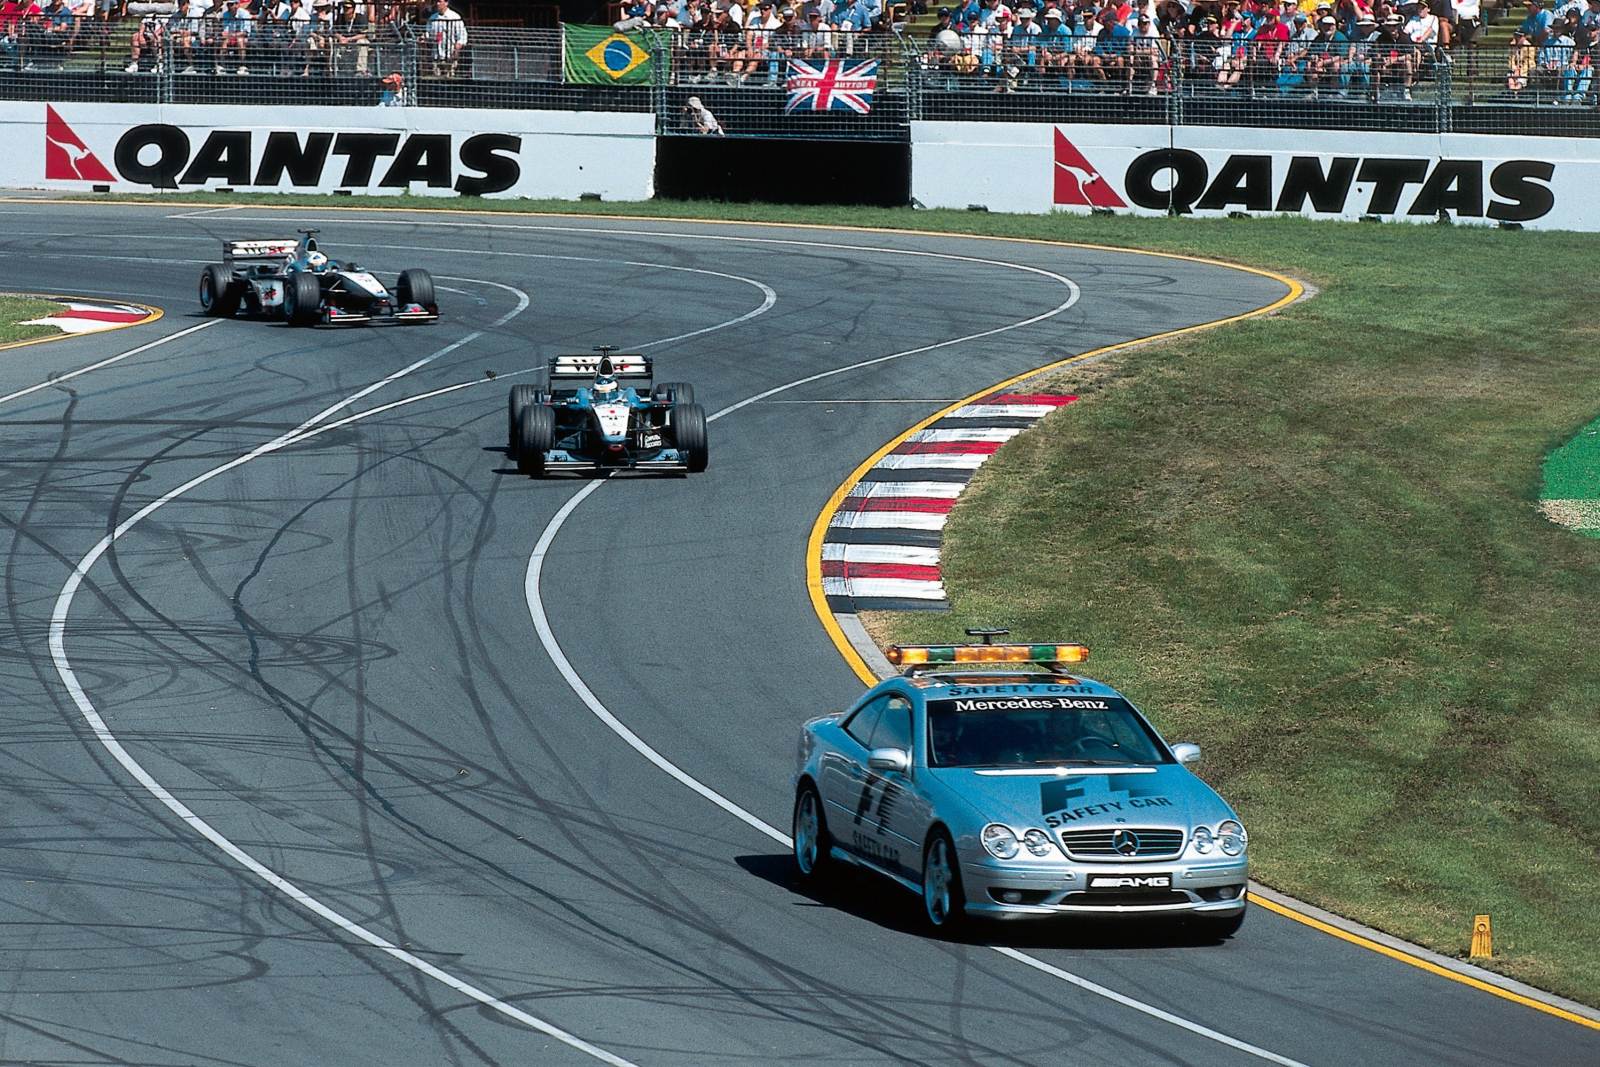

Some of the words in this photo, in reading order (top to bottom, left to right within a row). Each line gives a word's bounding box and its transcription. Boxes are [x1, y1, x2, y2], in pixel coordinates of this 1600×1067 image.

[114, 123, 521, 197] QANTAS
[1125, 147, 1555, 226] QANTAS
[949, 684, 1037, 696] SAFETY
[1047, 684, 1093, 695] CAR
[955, 698, 1109, 712] Mercedes-Benz
[1045, 801, 1124, 829] SAFETY
[1129, 797, 1173, 809] CAR
[1117, 877, 1170, 887] AMG
